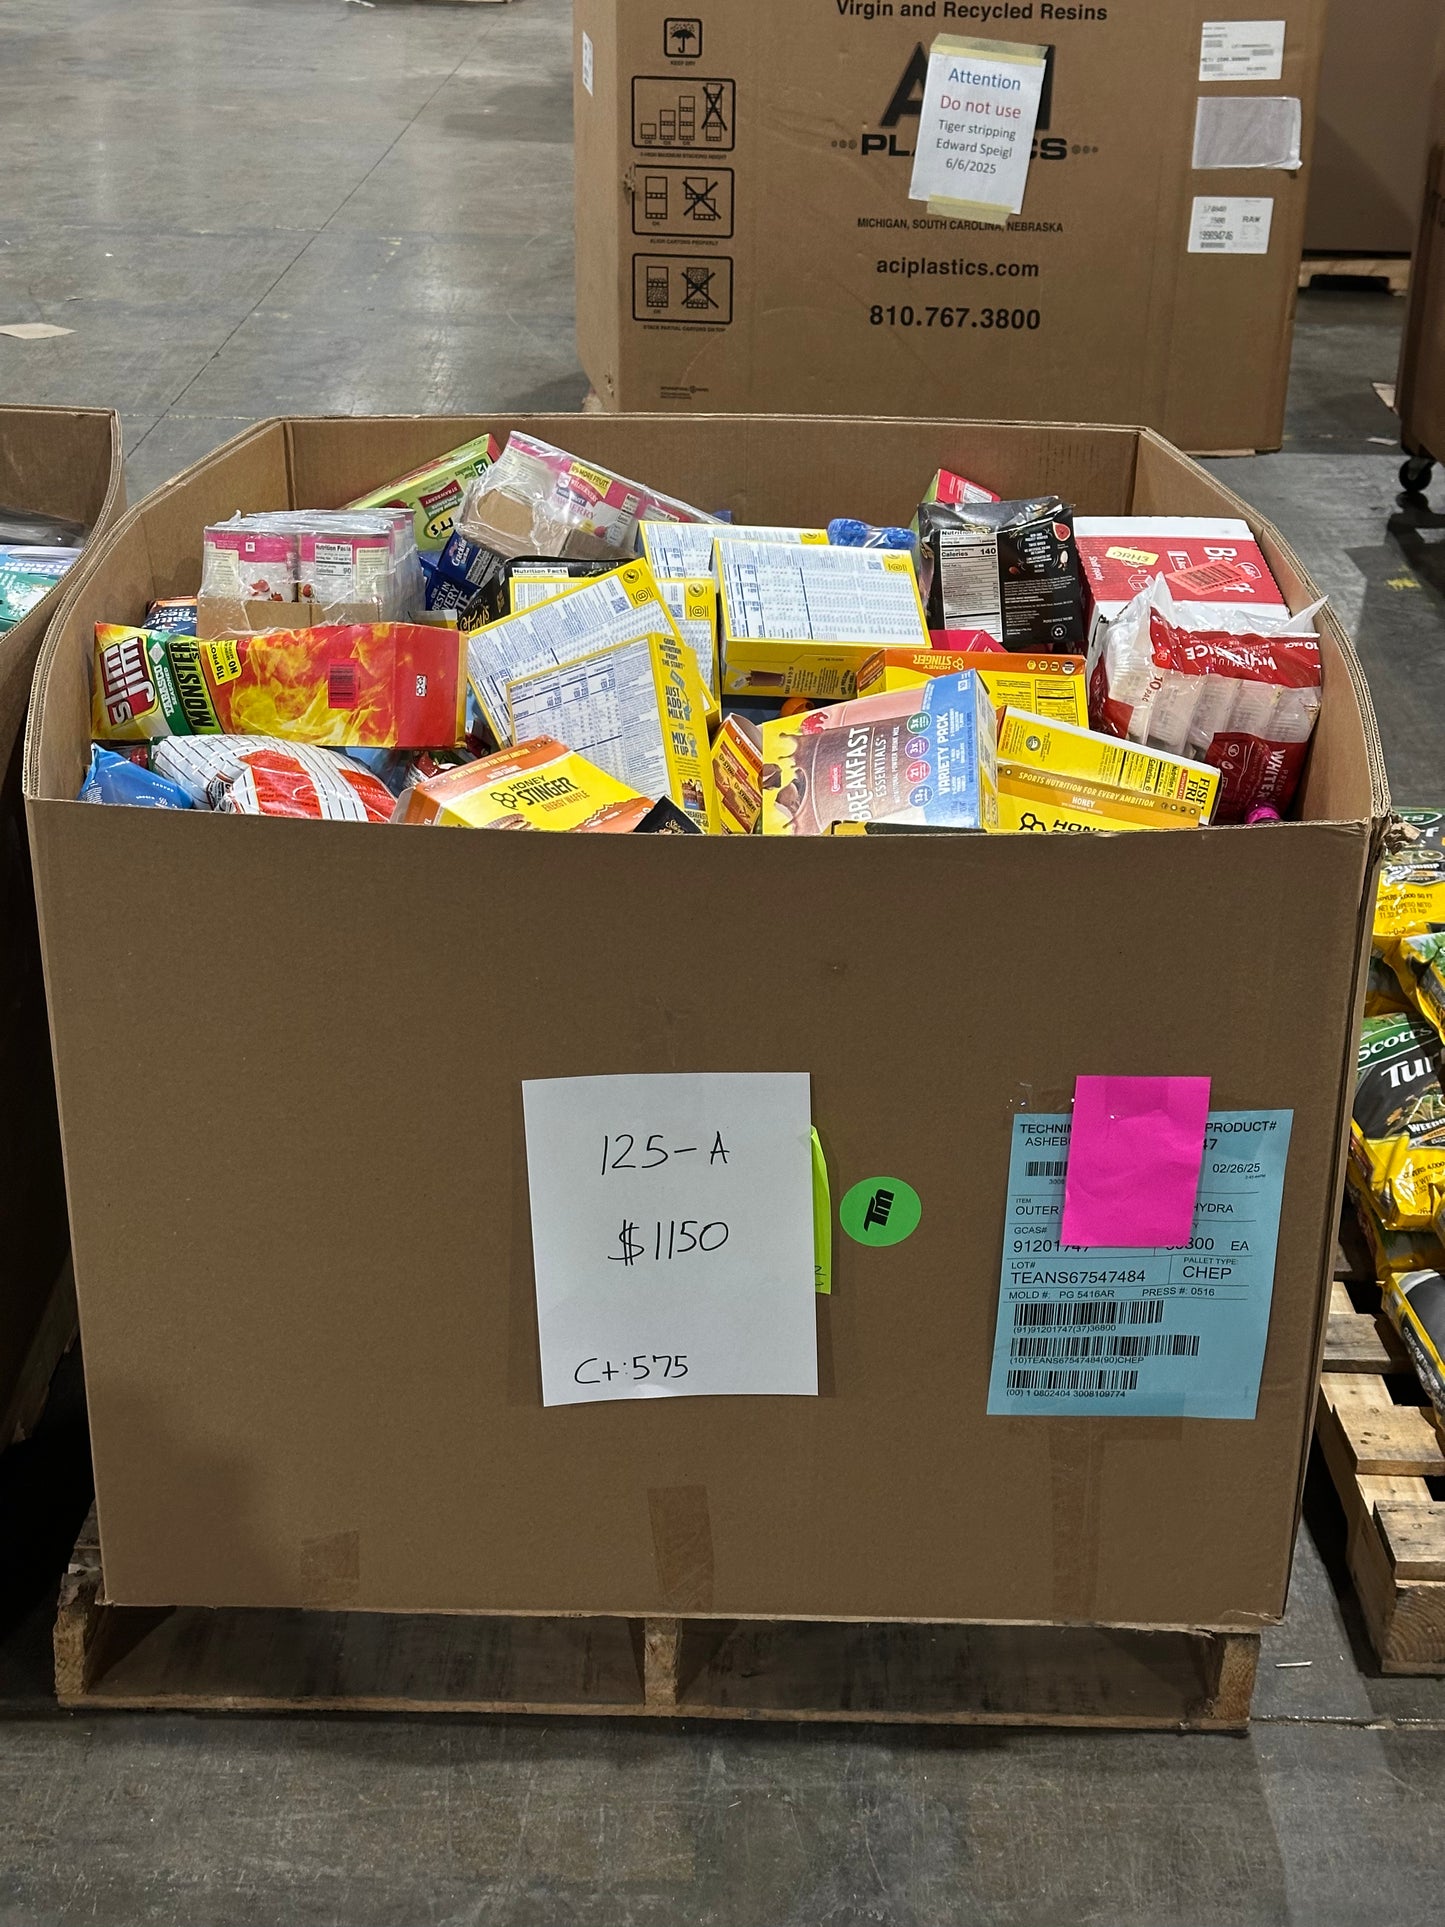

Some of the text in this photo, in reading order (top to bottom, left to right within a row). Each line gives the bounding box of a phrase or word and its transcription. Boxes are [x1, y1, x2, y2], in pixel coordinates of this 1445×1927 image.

[836, 0, 1108, 23] Virgin and Recycled Resins
[948, 67, 1021, 91] Attention
[940, 94, 1022, 119] Do not use
[938, 119, 1016, 141] Tiger stripping
[936, 138, 977, 154] Edward
[979, 142, 1012, 159] Speigl
[946, 158, 997, 175] 6/6/2025
[857, 218, 1063, 233] MICHIGAN, SOUTH CAROLINA, NEBRASKA
[876, 257, 1040, 278] aciplastics.com
[869, 305, 1041, 330] 810.767.3800
[580, 468, 593, 481] MORE
[593, 474, 609, 488] FRUIT
[425, 487, 458, 504] STRAWBERRY
[1305, 641, 1319, 650] 10
[228, 660, 239, 675] NO
[912, 654, 952, 665] STINGER
[154, 664, 175, 718] TABASCO
[169, 641, 215, 728] MONSTER
[666, 685, 680, 698] JUST
[1150, 677, 1164, 690] 10
[667, 697, 682, 709] ADD
[668, 708, 685, 721] MILK
[672, 731, 687, 746] MIX
[674, 744, 689, 757] IT UP
[936, 712, 951, 796] VARIETY PACK
[845, 726, 873, 820] BREAKFAST
[509, 775, 546, 792] HONEY
[517, 776, 578, 806] STINGER
[1018, 771, 1154, 808] SPORTS NUTRITION FOR EVERY AMBITION
[542, 789, 590, 812] ENERGY WAFFLE
[1072, 797, 1095, 808] HONEY
[1358, 1027, 1433, 1062] Scotts
[1204, 1121, 1277, 1132] PRODUCT#
[1025, 1137, 1071, 1146] ASHEB
[1212, 1163, 1260, 1173] 02/26/25
[1016, 1205, 1060, 1215] OUTER
[607, 1219, 729, 1266] $1150
[1231, 1241, 1249, 1251] EA
[1011, 1261, 1036, 1269] LOT#
[1011, 1265, 1232, 1284] TEANS67547484 CHEP
[1009, 1291, 1039, 1299] MOLD
[1060, 1290, 1074, 1299] PG
[1077, 1289, 1115, 1298] 5416AR
[1142, 1286, 1177, 1296] PRESS
[1191, 1287, 1215, 1296] 0516
[1006, 1388, 1024, 1397] (00)
